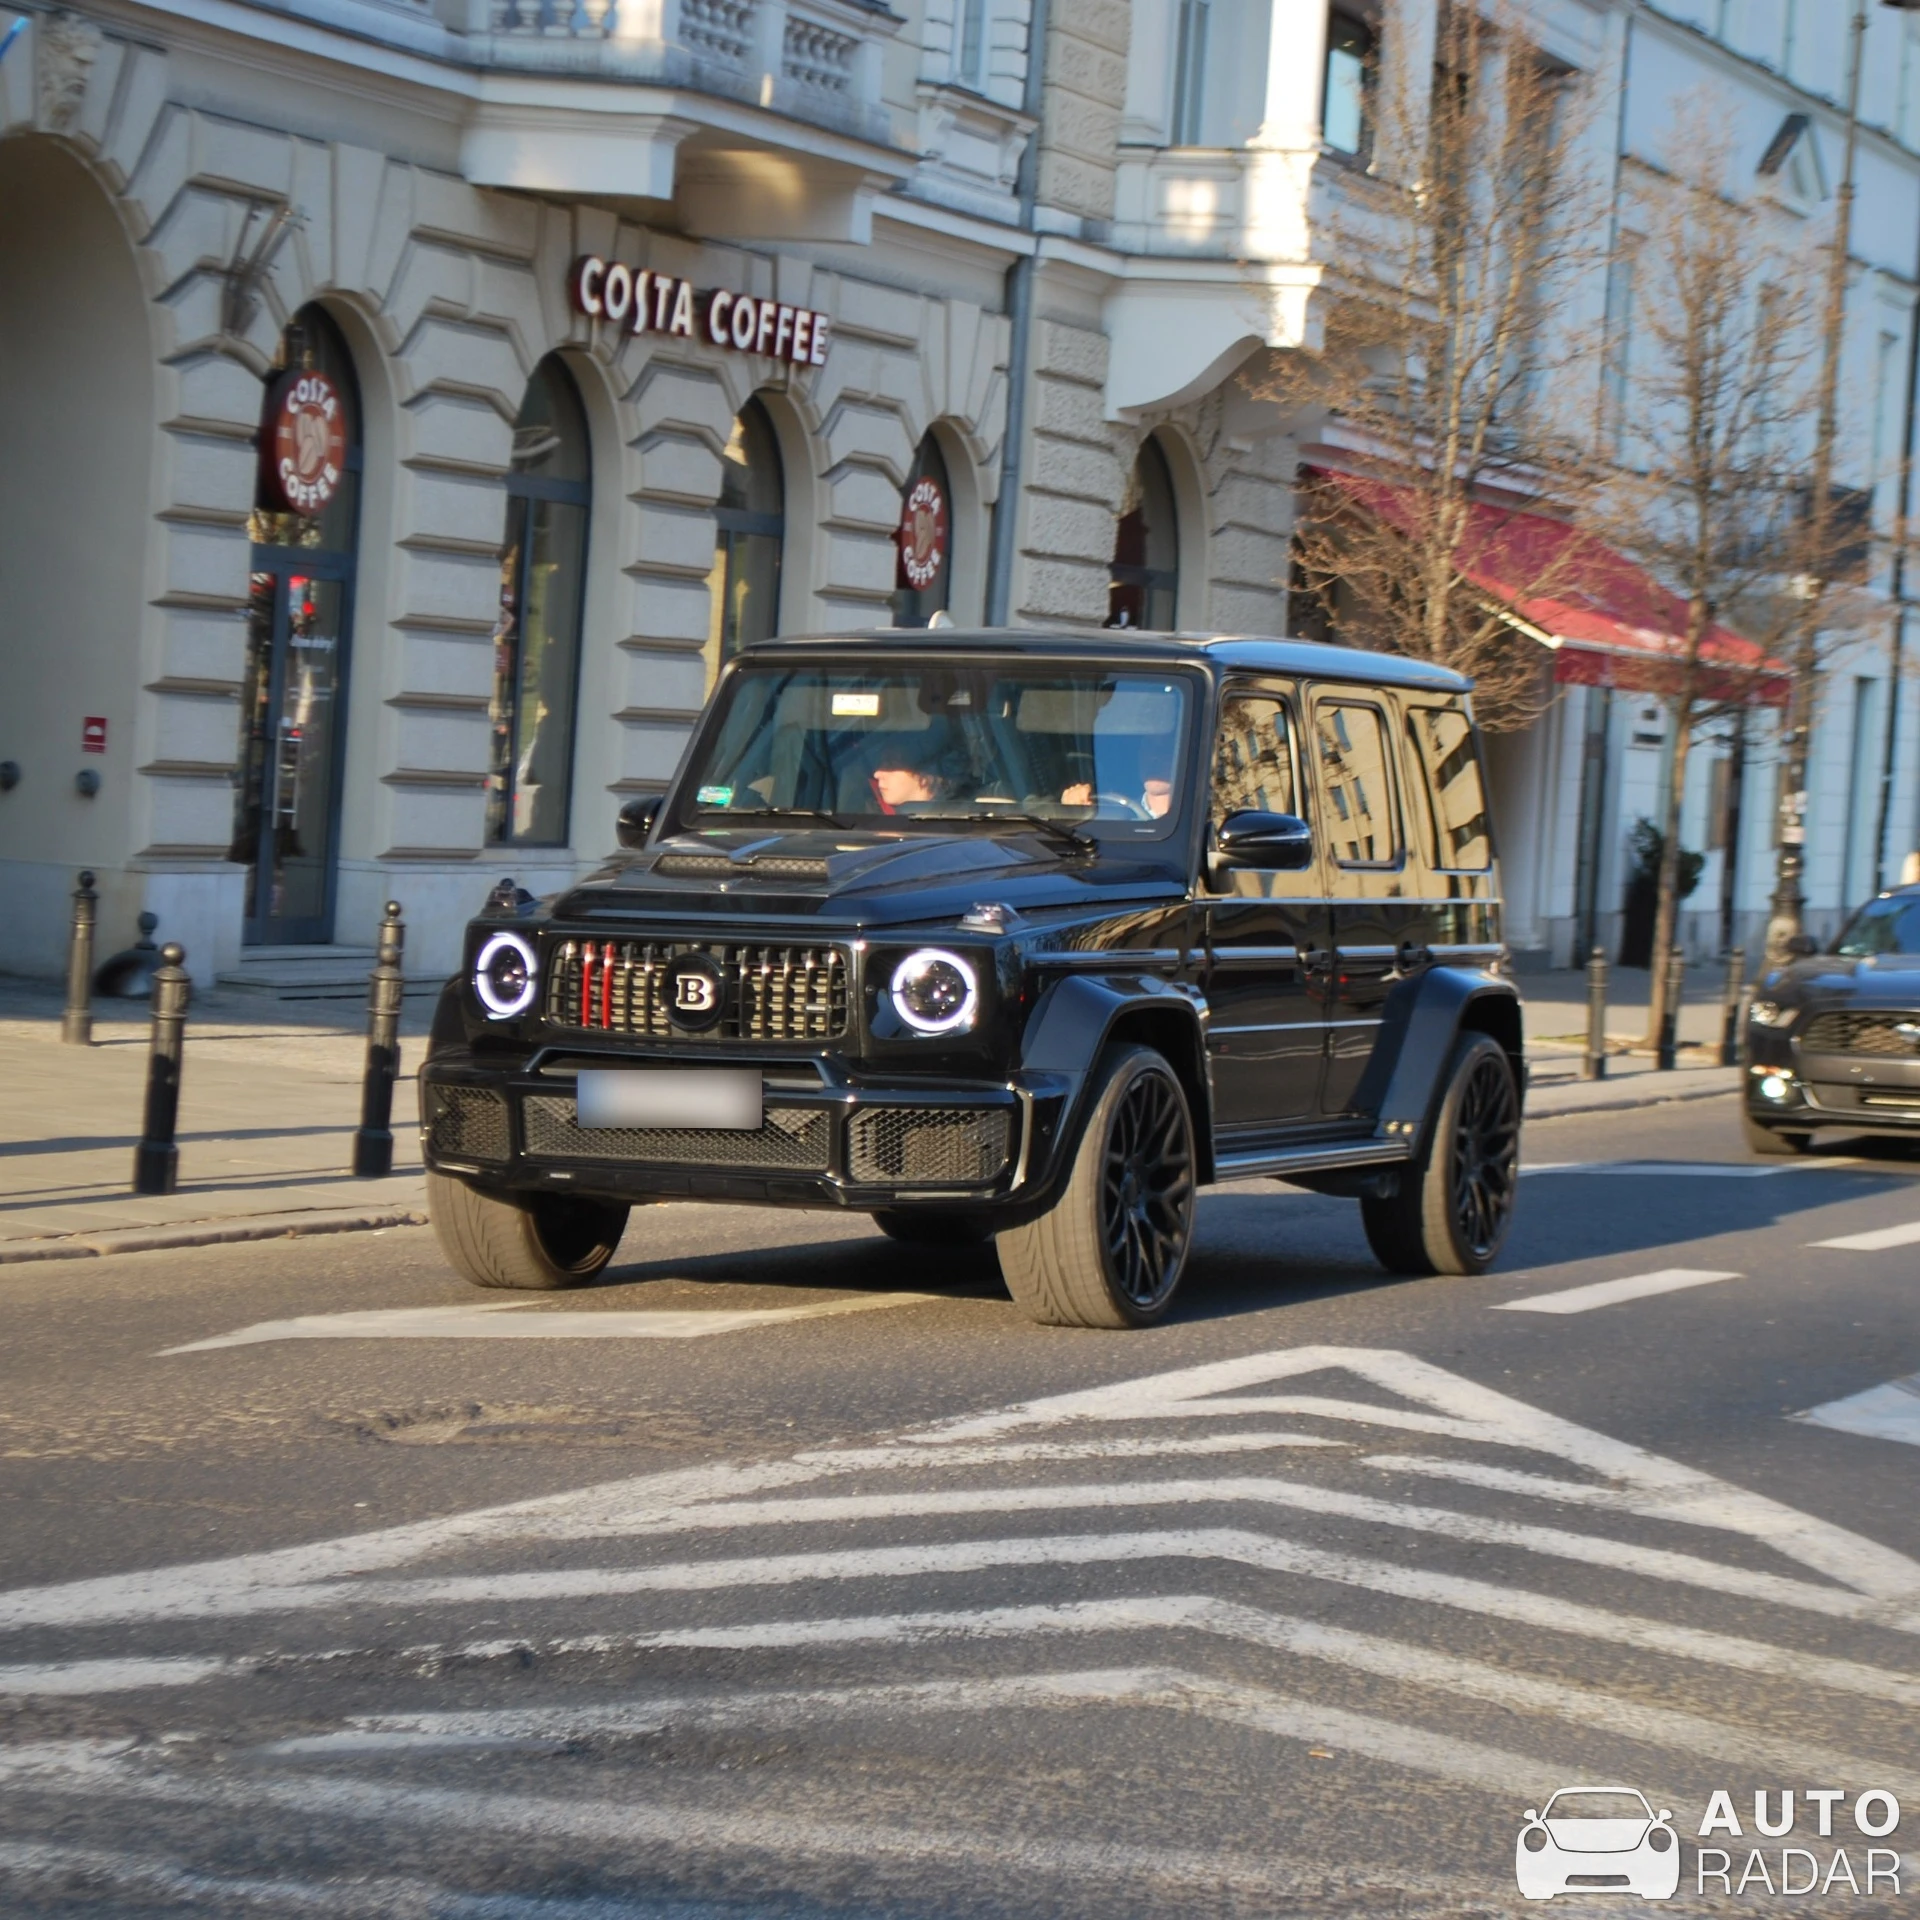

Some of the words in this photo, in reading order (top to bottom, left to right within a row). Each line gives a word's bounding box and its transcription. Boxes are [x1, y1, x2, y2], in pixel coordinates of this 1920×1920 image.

[578, 256, 692, 335] COSTA
[708, 290, 828, 366] COFFEE
[287, 378, 336, 420] COSTA
[280, 458, 338, 508] COFFEE
[909, 482, 940, 515] COSTA
[904, 546, 940, 585] COFFEE
[676, 975, 714, 1011] B
